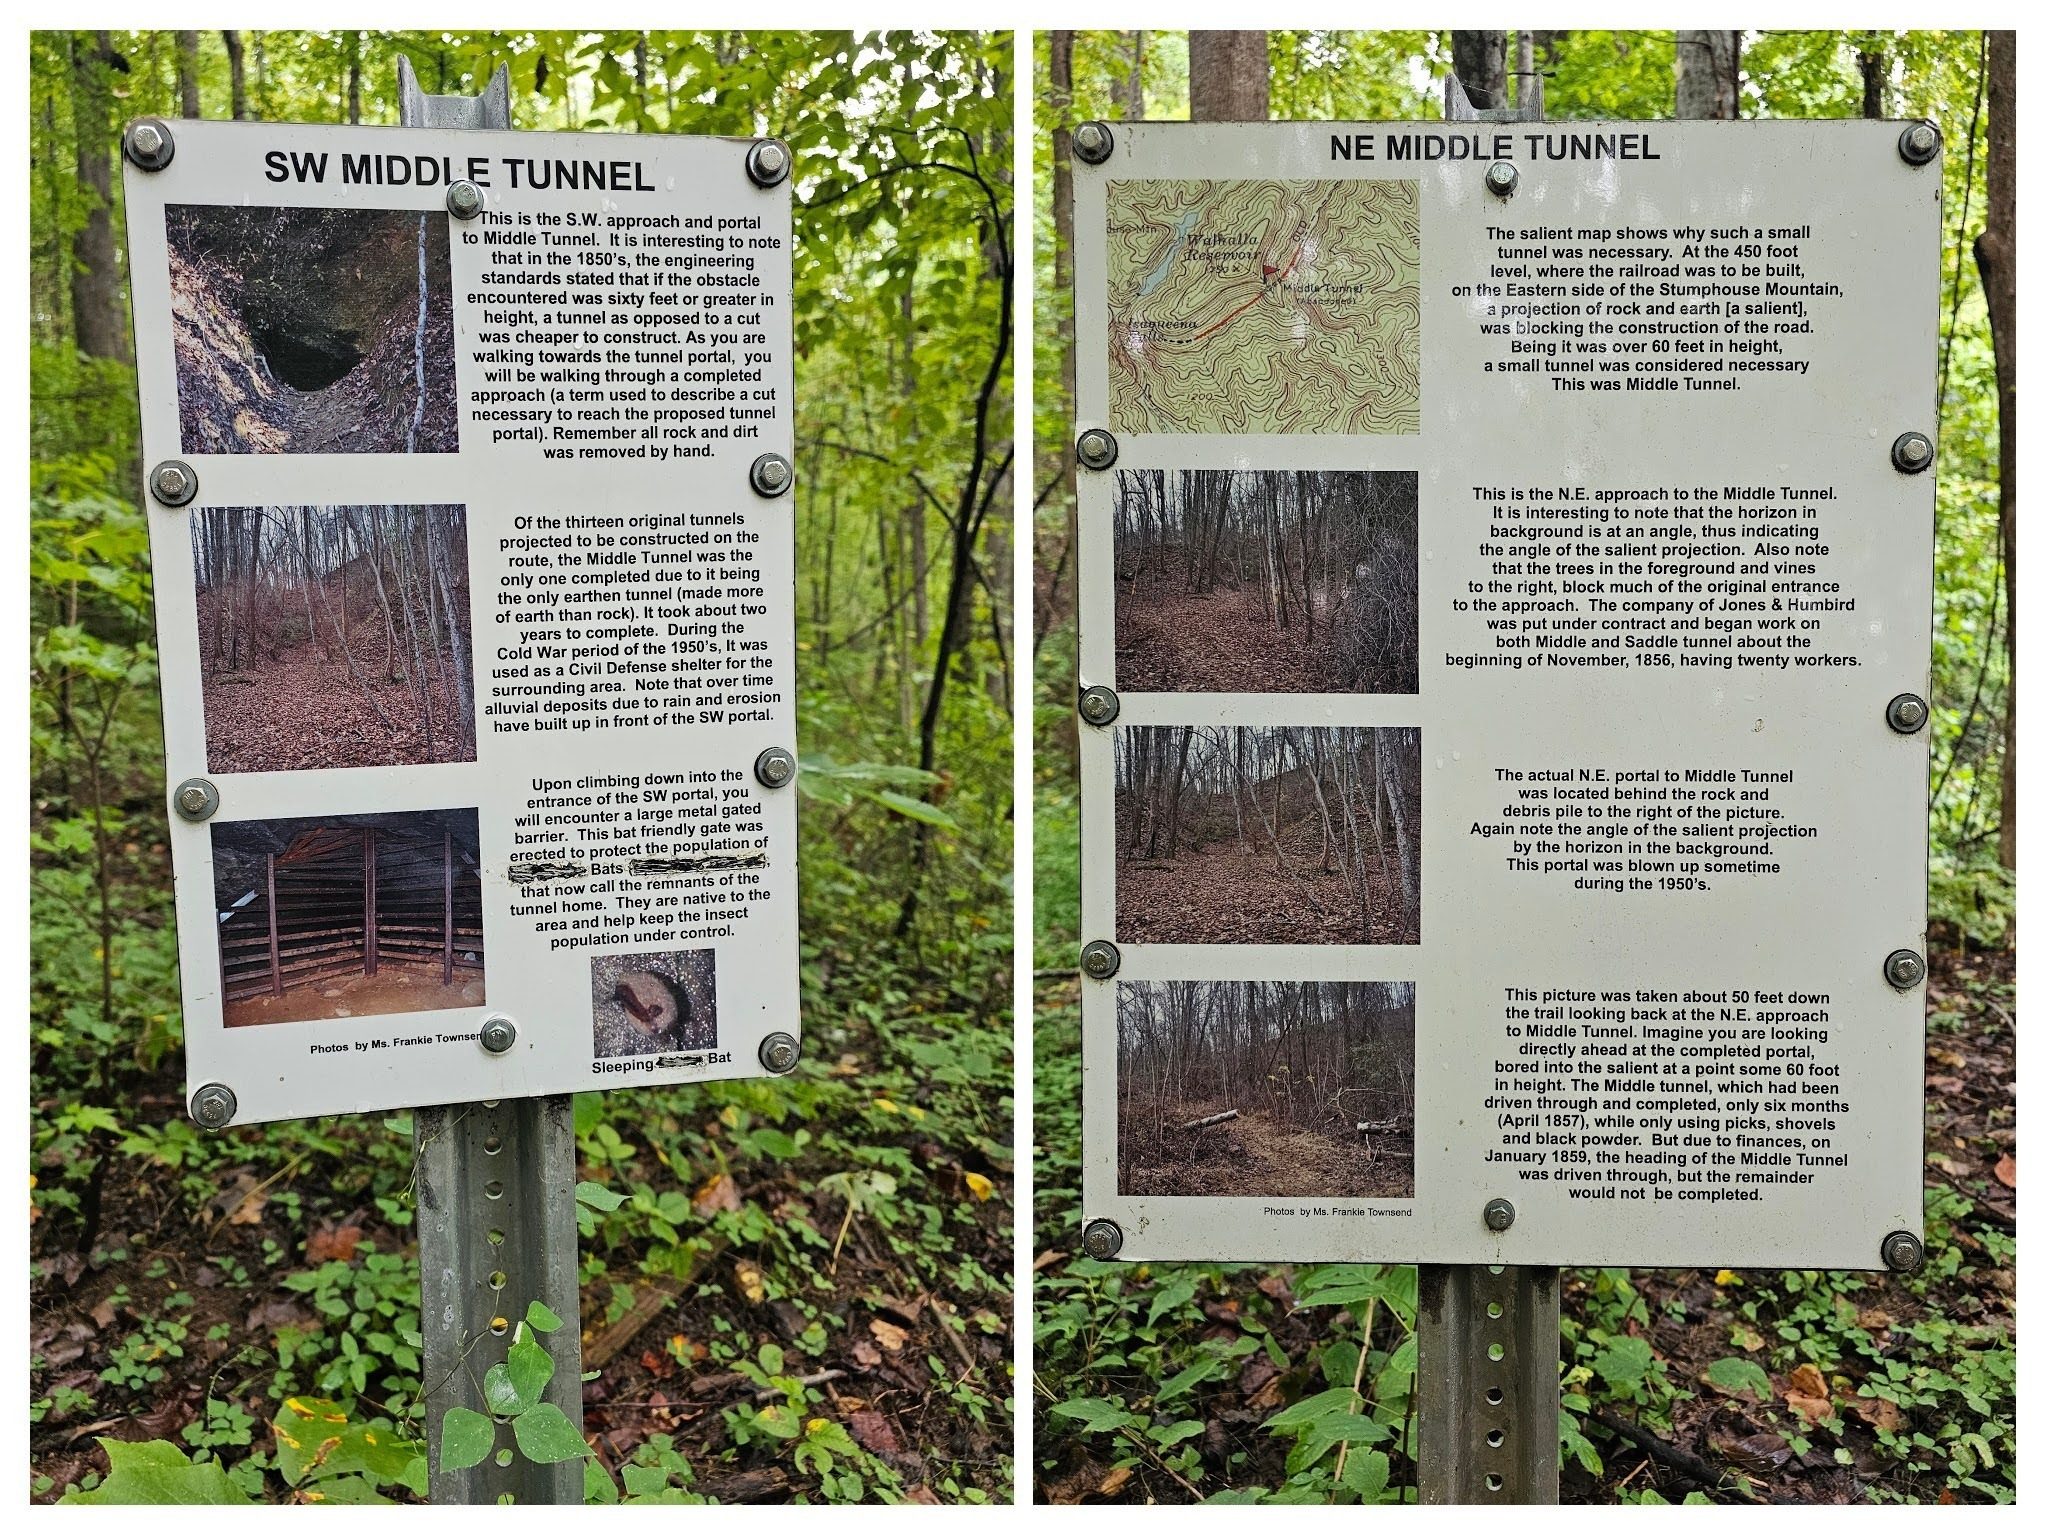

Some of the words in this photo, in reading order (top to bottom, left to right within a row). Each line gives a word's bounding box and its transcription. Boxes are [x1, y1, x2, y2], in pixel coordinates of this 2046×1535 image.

[1331, 135, 1374, 160] NE
[1387, 135, 1513, 160] MIDDLE
[1524, 134, 1660, 160] TUNNEL
[265, 151, 328, 183] SW
[341, 154, 490, 187] MIDDLE
[502, 158, 655, 191] TUNNEL
[480, 211, 512, 225] This
[518, 212, 531, 225] is
[536, 212, 561, 226] the
[566, 212, 601, 226] S.W.
[607, 214, 680, 230] approach
[685, 215, 712, 228] and
[718, 216, 760, 232] portal
[1186, 234, 1258, 246] Walhalla
[491, 251, 523, 264] that
[528, 251, 542, 264] in
[546, 251, 571, 265] the
[635, 253, 660, 266] the
[664, 254, 754, 271] engineering
[1185, 250, 1261, 261] Reservoir
[1498, 246, 1546, 258] tunnel
[1552, 249, 1583, 258] was
[1589, 248, 1672, 261] necessary.
[1682, 245, 1700, 258] At
[1704, 245, 1729, 258] the
[1734, 245, 1761, 258] 450
[1767, 244, 1798, 257] foot
[1452, 286, 1471, 296] on
[1476, 284, 1501, 296] the
[1507, 283, 1566, 296] Eastern
[1572, 283, 1604, 296] side
[1610, 283, 1626, 296] of
[1630, 283, 1654, 296] the
[1660, 283, 1760, 299] Stumphouse
[1766, 282, 1843, 298] Mountain,
[1552, 378, 1585, 390] This
[1590, 381, 1621, 390] was
[1627, 378, 1678, 390] Middle
[1684, 377, 1740, 390] Tunnel.
[472, 411, 552, 424] necessary
[557, 408, 572, 420] to
[578, 407, 620, 420] reach
[625, 407, 648, 420] the
[654, 406, 724, 423] proposed
[730, 406, 775, 419] tunnel
[543, 449, 574, 458] was
[579, 445, 645, 458] removed
[651, 444, 668, 461] by
[674, 444, 714, 457] hand.
[514, 516, 533, 529] Of
[536, 516, 560, 529] the
[565, 516, 624, 528] thirteen
[629, 513, 685, 530] original
[690, 512, 744, 526] tunnels
[509, 554, 552, 568] route,
[558, 553, 582, 566] the
[587, 552, 636, 565] Middle
[641, 550, 692, 564] Tunnel
[696, 552, 726, 562] was
[730, 549, 752, 561] the
[1453, 599, 1468, 611] to
[1473, 598, 1496, 611] the
[1502, 599, 1578, 614] approach.
[1588, 599, 1617, 611] The
[1622, 602, 1694, 614] company
[1699, 598, 1715, 611] of
[1719, 598, 1766, 611] Jones
[1772, 598, 1782, 610] &
[1788, 598, 1854, 611] Humbird
[498, 647, 532, 660] Cold
[537, 646, 567, 658] War
[572, 644, 619, 661] period
[624, 643, 639, 655] of
[643, 642, 666, 655] the
[727, 640, 736, 651] It
[740, 641, 768, 650] was
[1446, 653, 1522, 669] beginning
[1528, 654, 1543, 666] of
[1548, 654, 1628, 668] November,
[1635, 654, 1674, 668] 1856,
[1681, 654, 1732, 669] having
[1738, 654, 1790, 669] twenty
[1794, 654, 1861, 666] workers.
[494, 720, 529, 732] have
[535, 718, 568, 730] built
[572, 720, 590, 732] up
[596, 716, 608, 728] in
[613, 714, 649, 727] front
[653, 713, 668, 725] of
[672, 712, 694, 724] the
[700, 710, 724, 723] SW
[729, 708, 773, 725] portal.
[532, 778, 572, 793] Upon
[577, 775, 639, 789] climbing
[644, 773, 684, 785] down
[689, 771, 716, 783] into
[720, 769, 743, 781] the
[1495, 769, 1523, 781] The
[1528, 769, 1573, 781] actual
[1580, 769, 1609, 781] N.E.
[1616, 770, 1659, 784] portal
[1664, 770, 1679, 782] to
[1685, 770, 1736, 782] Middle
[1741, 770, 1792, 782] Tunnel
[515, 814, 540, 827] will
[545, 811, 620, 825] encounter
[624, 812, 632, 821] a
[637, 808, 673, 822] large
[678, 804, 716, 818] metal
[722, 802, 761, 818] gated
[591, 863, 623, 875] Bats
[1575, 877, 1623, 892] during
[1629, 877, 1652, 890] the
[551, 932, 628, 951] population
[634, 929, 676, 942] under
[680, 924, 734, 939] control.
[310, 1044, 349, 1054] Photos
[355, 1042, 368, 1052] by
[372, 1040, 390, 1048] Ms.
[394, 1036, 432, 1046] Frankie
[435, 1033, 481, 1043] Townsen
[592, 1059, 654, 1074] Sleeping
[708, 1052, 731, 1064] Bat
[1498, 1114, 1538, 1129] (April
[1545, 1114, 1589, 1130] 1857),
[1594, 1115, 1634, 1128] while
[1640, 1116, 1672, 1131] only
[1678, 1116, 1720, 1132] using
[1726, 1117, 1770, 1132] picks,
[1776, 1117, 1835, 1130] shovels
[1485, 1149, 1546, 1165] January
[1552, 1150, 1590, 1165] 1859,
[1596, 1151, 1620, 1163] the
[1626, 1151, 1686, 1167] heading
[1692, 1152, 1708, 1164] of
[1711, 1152, 1735, 1164] the
[1741, 1152, 1791, 1165] Middle
[1796, 1153, 1847, 1166] Tunnel
[1569, 1186, 1615, 1199] would
[1621, 1188, 1645, 1199] not
[1655, 1187, 1672, 1199] be
[1678, 1188, 1762, 1203] completed.
[1264, 1207, 1294, 1215] Photos
[1300, 1208, 1310, 1217] by
[1332, 1208, 1364, 1216] Frankie
[1368, 1208, 1412, 1216] Townsend
